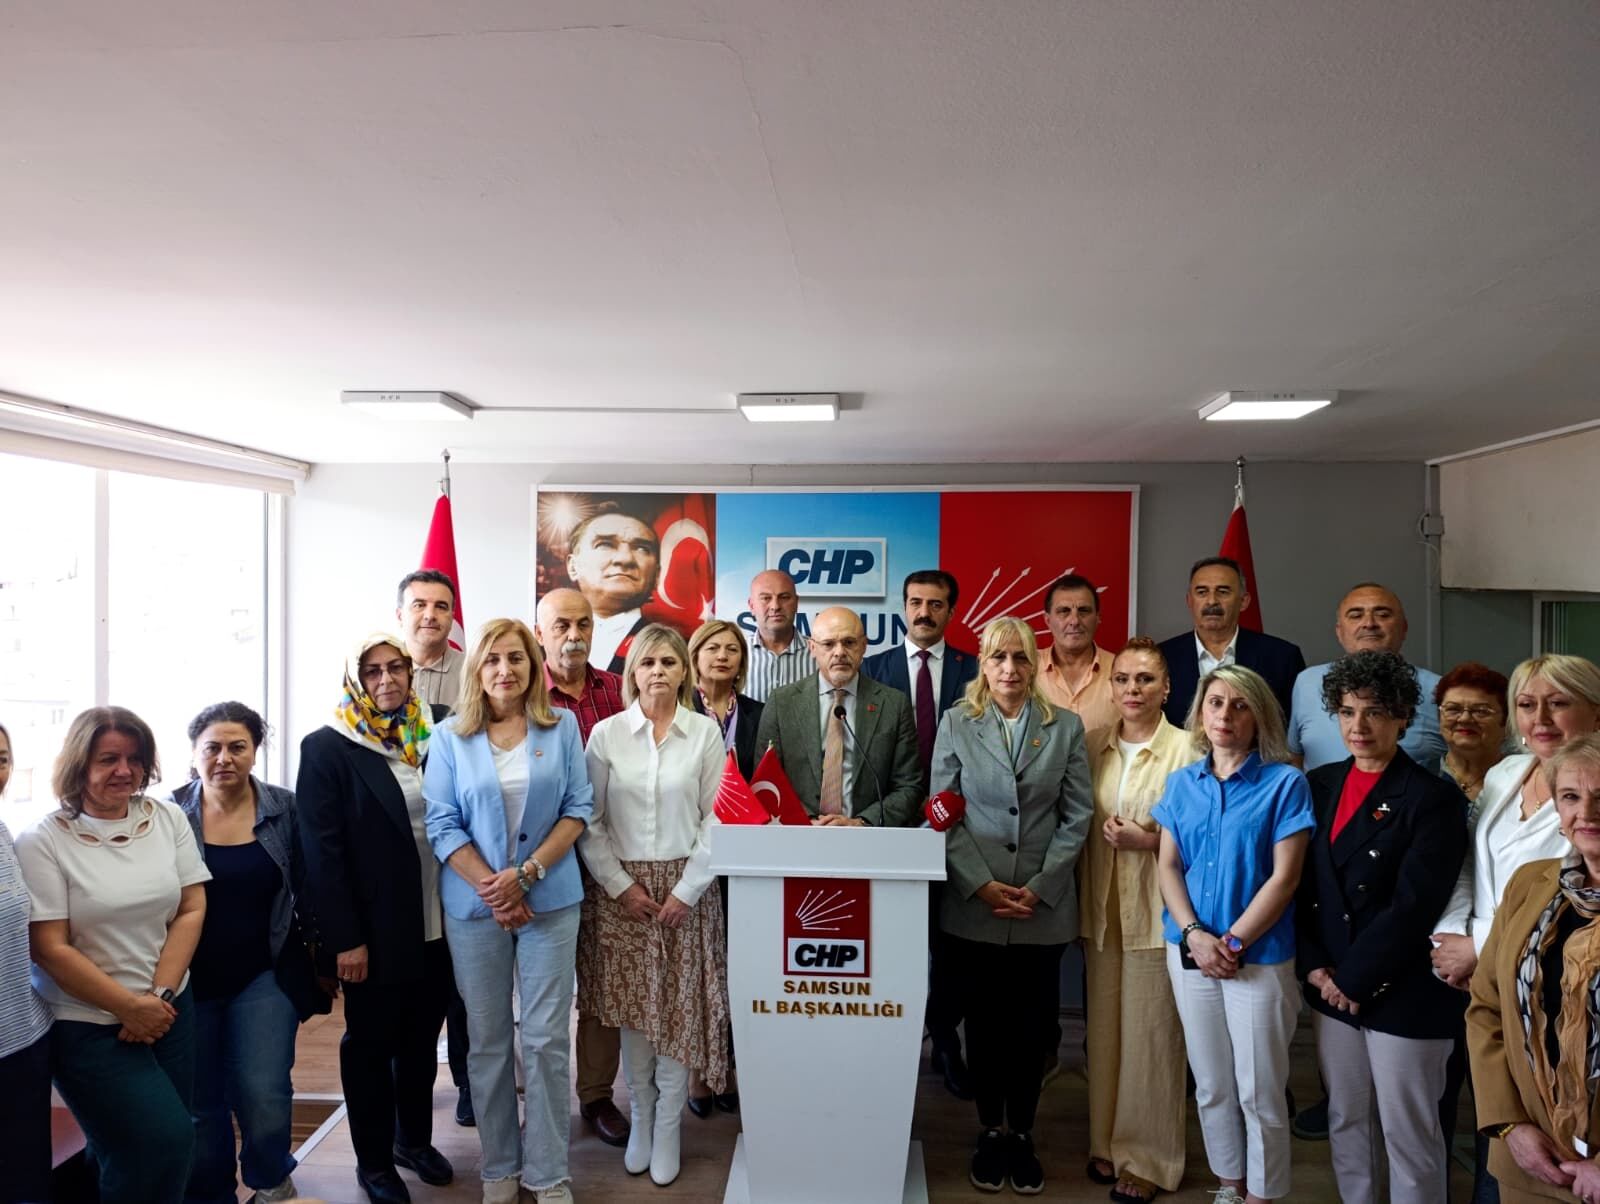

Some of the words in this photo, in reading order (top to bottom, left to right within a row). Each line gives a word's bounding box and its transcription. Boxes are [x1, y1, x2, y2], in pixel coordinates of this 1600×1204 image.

[778, 548, 875, 584] CHP
[736, 611, 908, 645] SUN
[794, 943, 859, 968] CHP
[783, 980, 871, 996] SAMSUN
[776, 1000, 904, 1019] BAŞKANLIĞI
